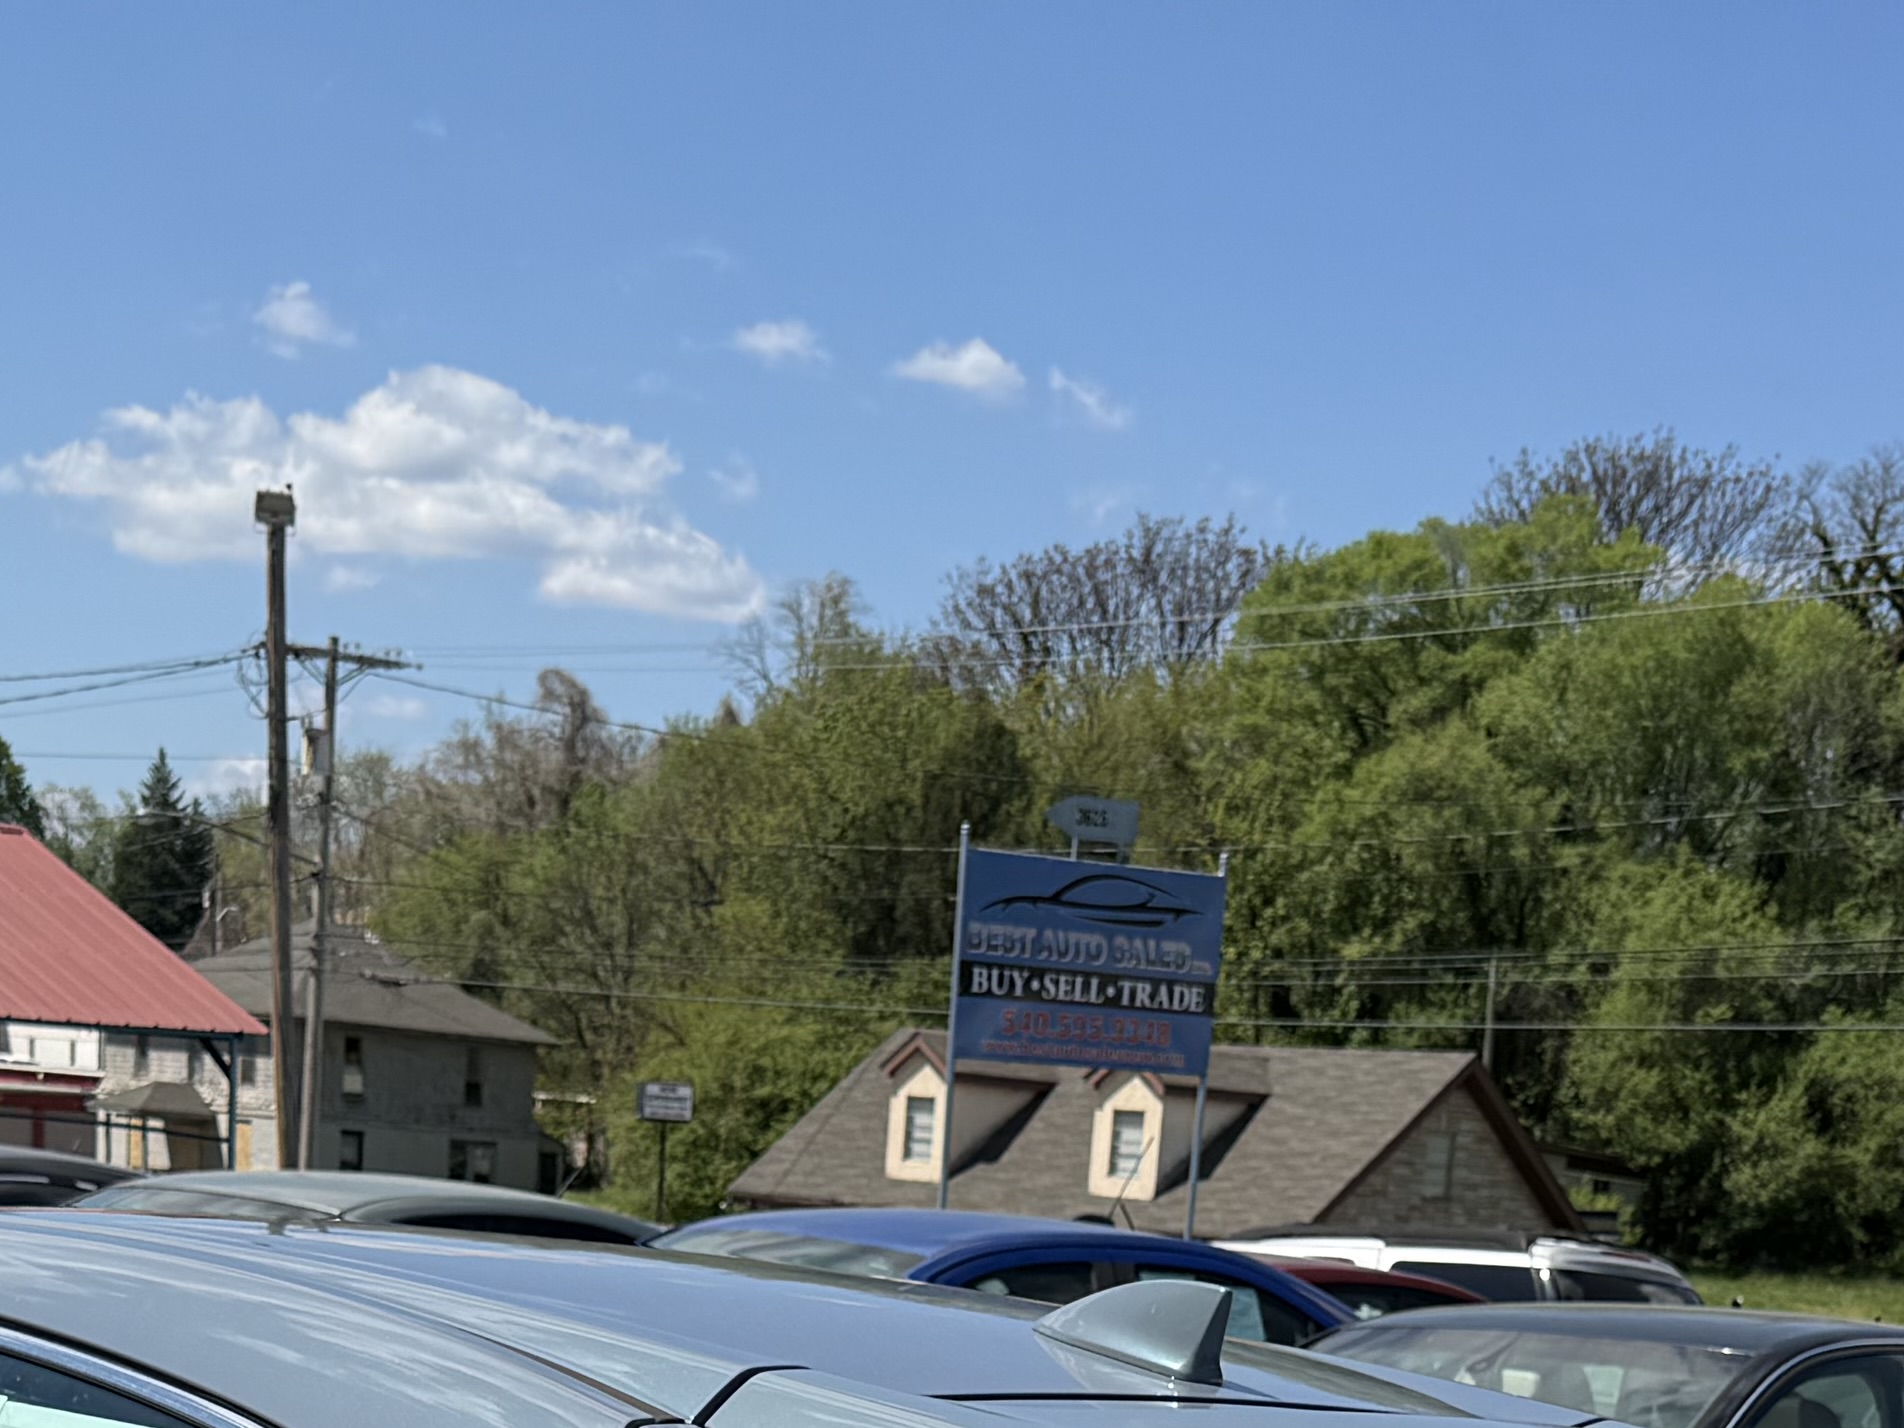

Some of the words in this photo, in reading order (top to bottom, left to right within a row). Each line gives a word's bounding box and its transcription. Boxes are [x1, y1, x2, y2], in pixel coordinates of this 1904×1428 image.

[967, 921, 1037, 958] BEST
[1038, 929, 1108, 966] AUTO
[1113, 935, 1193, 974] SALES
[970, 966, 1029, 997] BUY
[1041, 973, 1105, 1005] SELL
[1117, 981, 1206, 1012] TRADE
